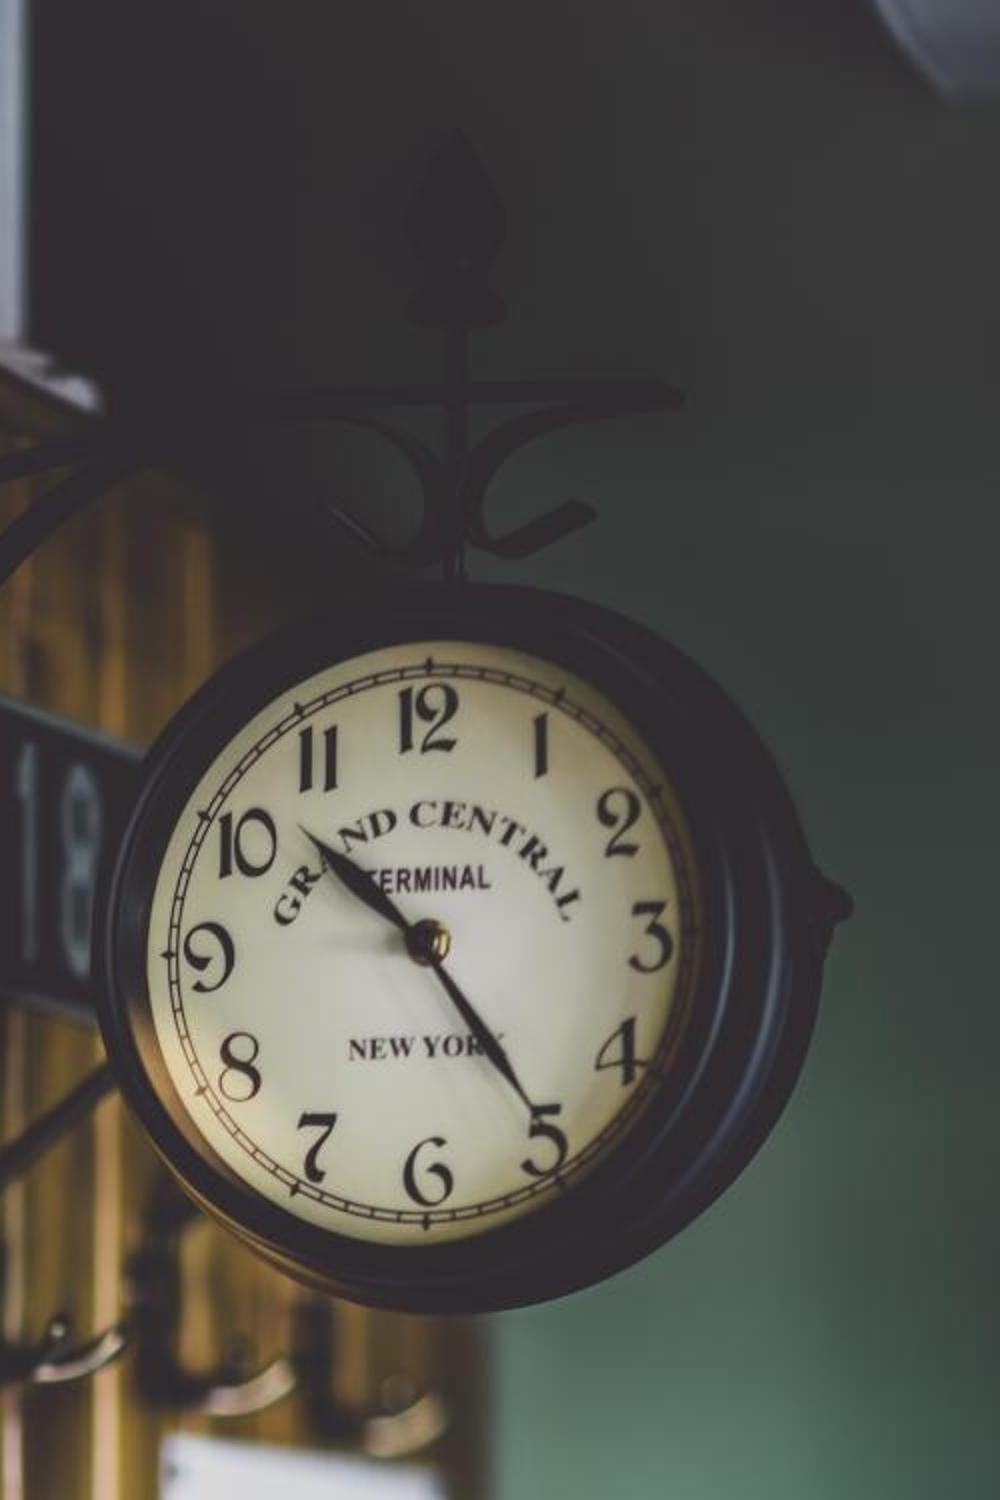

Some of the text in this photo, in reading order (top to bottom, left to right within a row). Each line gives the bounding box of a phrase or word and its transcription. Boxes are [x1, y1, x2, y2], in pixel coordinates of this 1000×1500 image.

[398, 683, 459, 754] 12
[533, 713, 548, 779] 1
[299, 724, 338, 793] 11
[218, 807, 277, 879] 10
[596, 786, 641, 857] 2
[410, 800, 583, 922] CENTRAL
[184, 921, 236, 993] 9
[627, 902, 673, 973] 3
[219, 1032, 262, 1102] 8
[348, 1033, 504, 1061] NEW YOR
[595, 1016, 648, 1087] 4
[297, 1113, 338, 1183] 7
[403, 1137, 453, 1207] 6
[521, 1104, 568, 1179] 5
